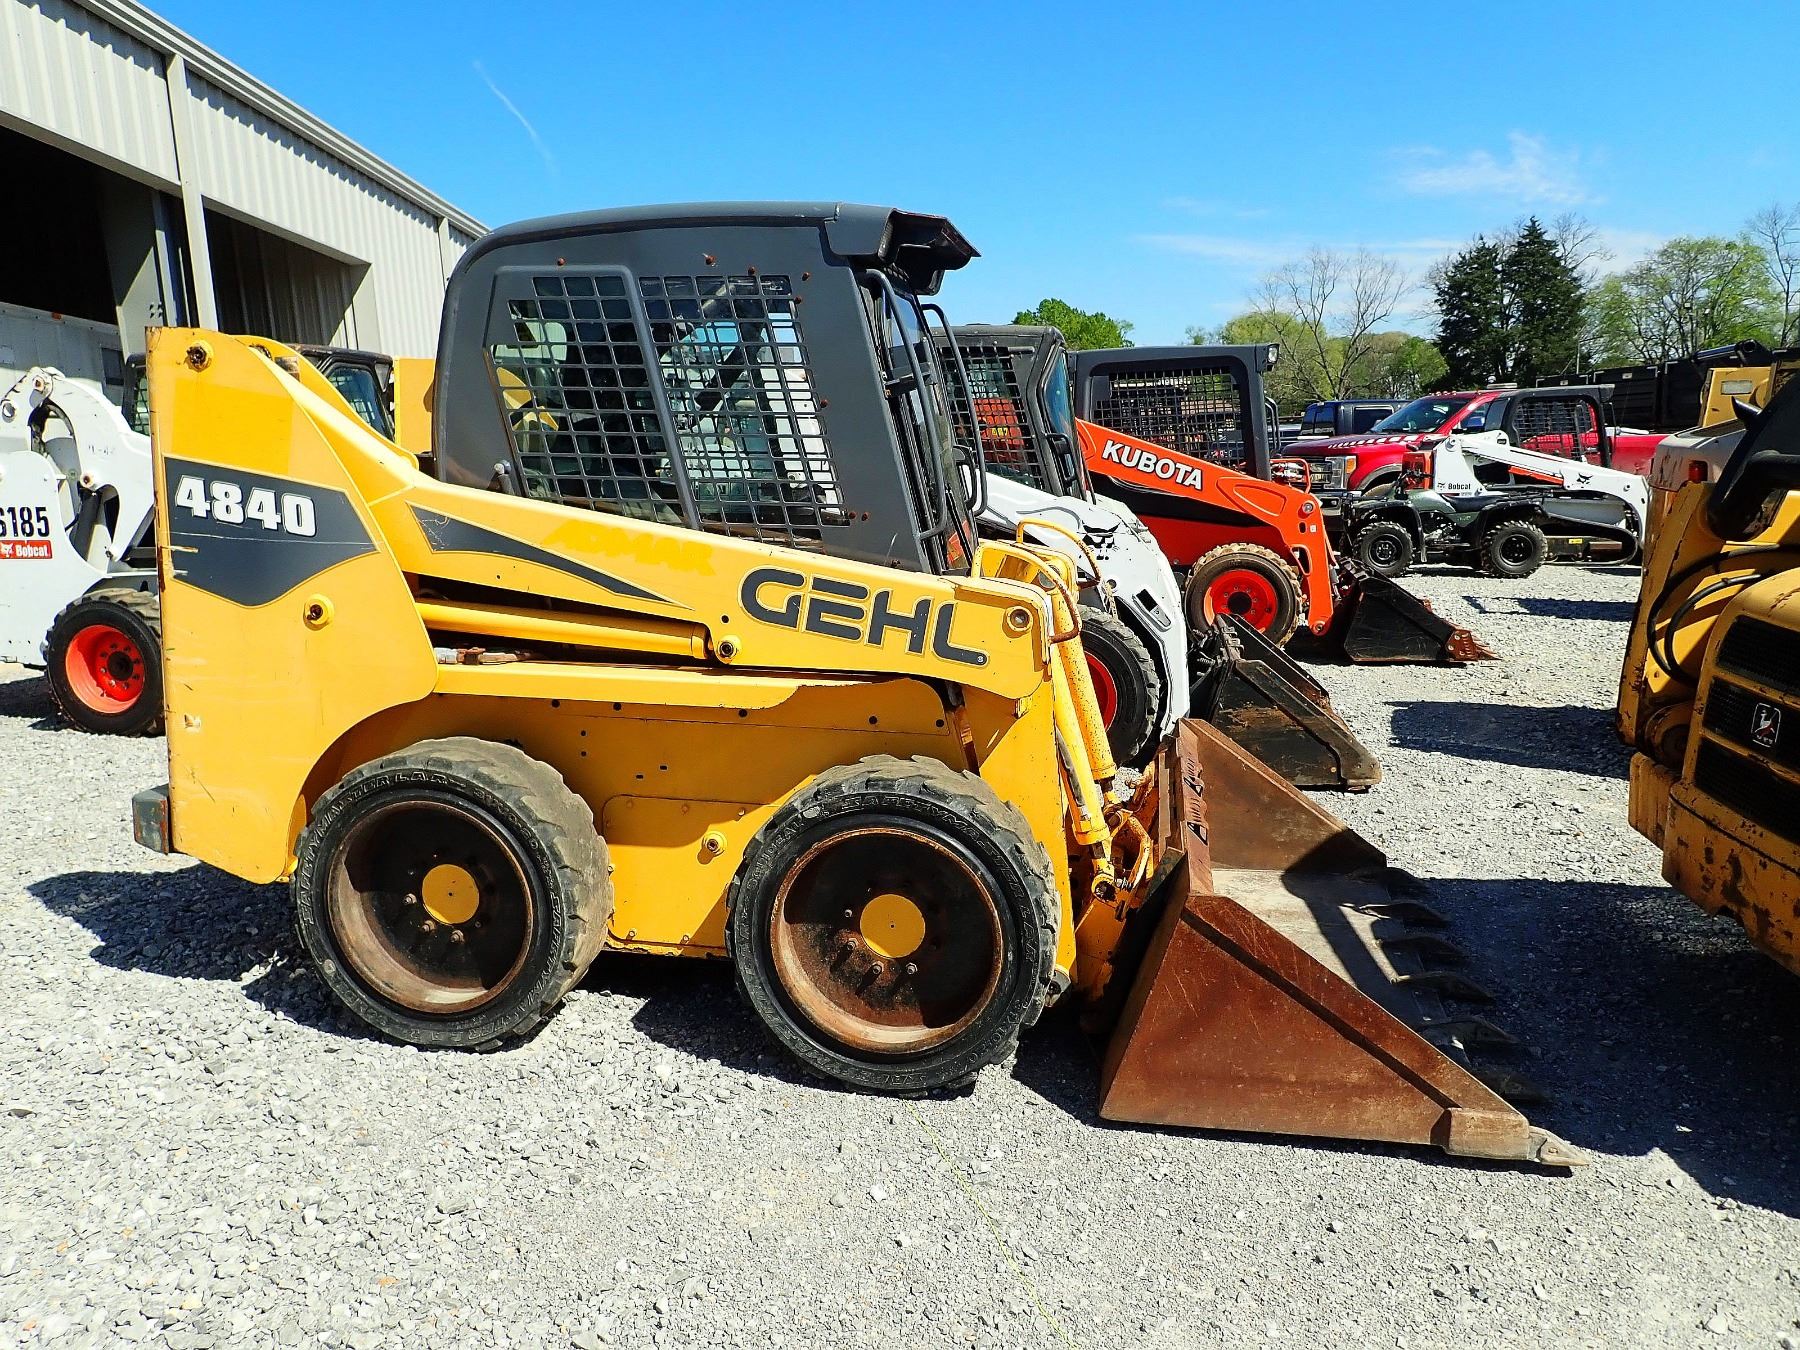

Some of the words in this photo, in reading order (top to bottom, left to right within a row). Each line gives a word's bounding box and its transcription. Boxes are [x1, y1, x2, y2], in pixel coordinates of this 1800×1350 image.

[1102, 439, 1203, 491] KUBOTA
[175, 475, 317, 537] 4840
[15, 543, 48, 557] Bobcat
[741, 568, 988, 666] GEHL
